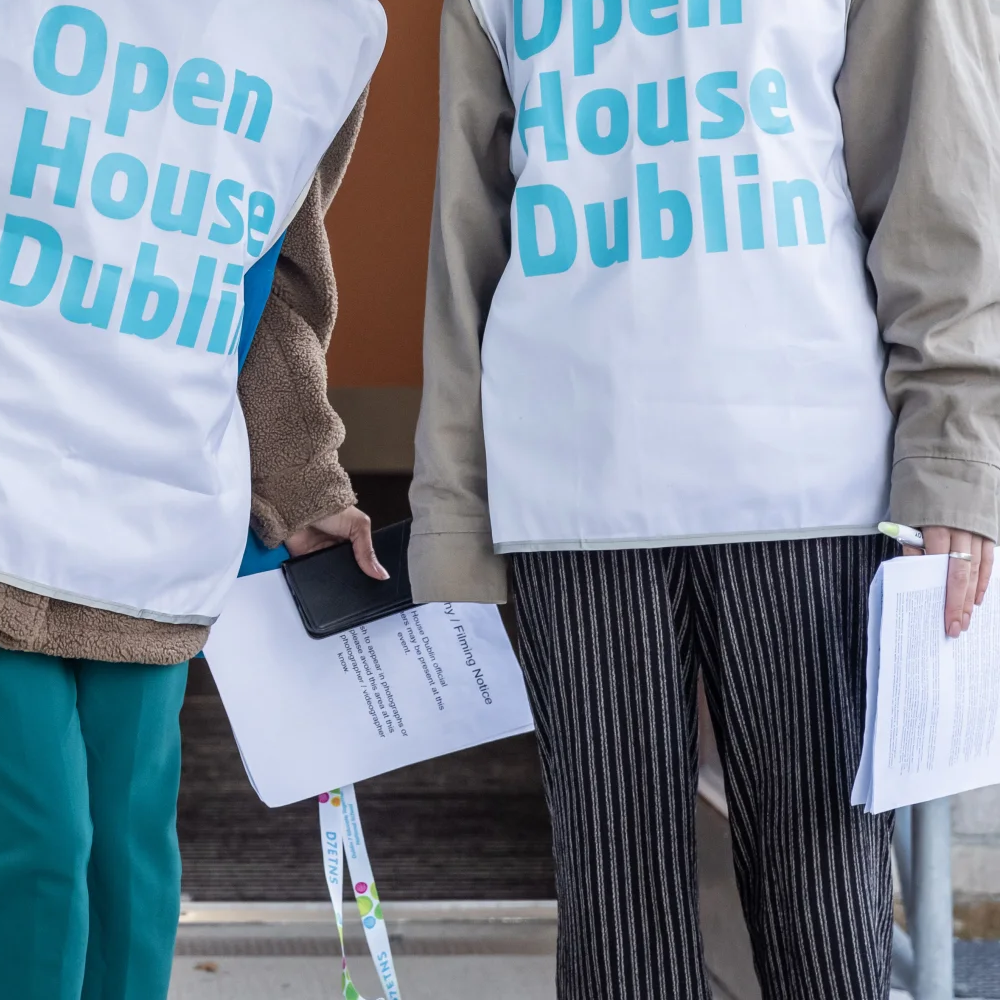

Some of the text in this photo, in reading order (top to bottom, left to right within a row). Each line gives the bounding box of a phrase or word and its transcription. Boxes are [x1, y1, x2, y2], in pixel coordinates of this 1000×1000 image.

[32, 4, 274, 144] Open
[517, 67, 795, 163] House
[9, 106, 276, 258] House
[515, 153, 827, 278] Dublin
[337, 652, 349, 674] know.
[364, 635, 371, 644] to
[368, 645, 382, 671] appear
[378, 672, 385, 680] in
[397, 632, 411, 655] event.
[407, 627, 417, 644] may
[414, 644, 421, 655] be
[418, 656, 435, 686] present
[431, 687, 439, 695] at
[435, 696, 444, 711] this
[411, 610, 448, 688] House Dublin official
[453, 625, 476, 667] Filming
[472, 668, 493, 705] Notice
[340, 634, 364, 683] photographer
[362, 689, 386, 738] videographer
[349, 629, 395, 734] please avoid this area at this
[381, 681, 404, 728] photographs
[400, 728, 408, 737] or
[325, 831, 338, 885] D7ETNS
